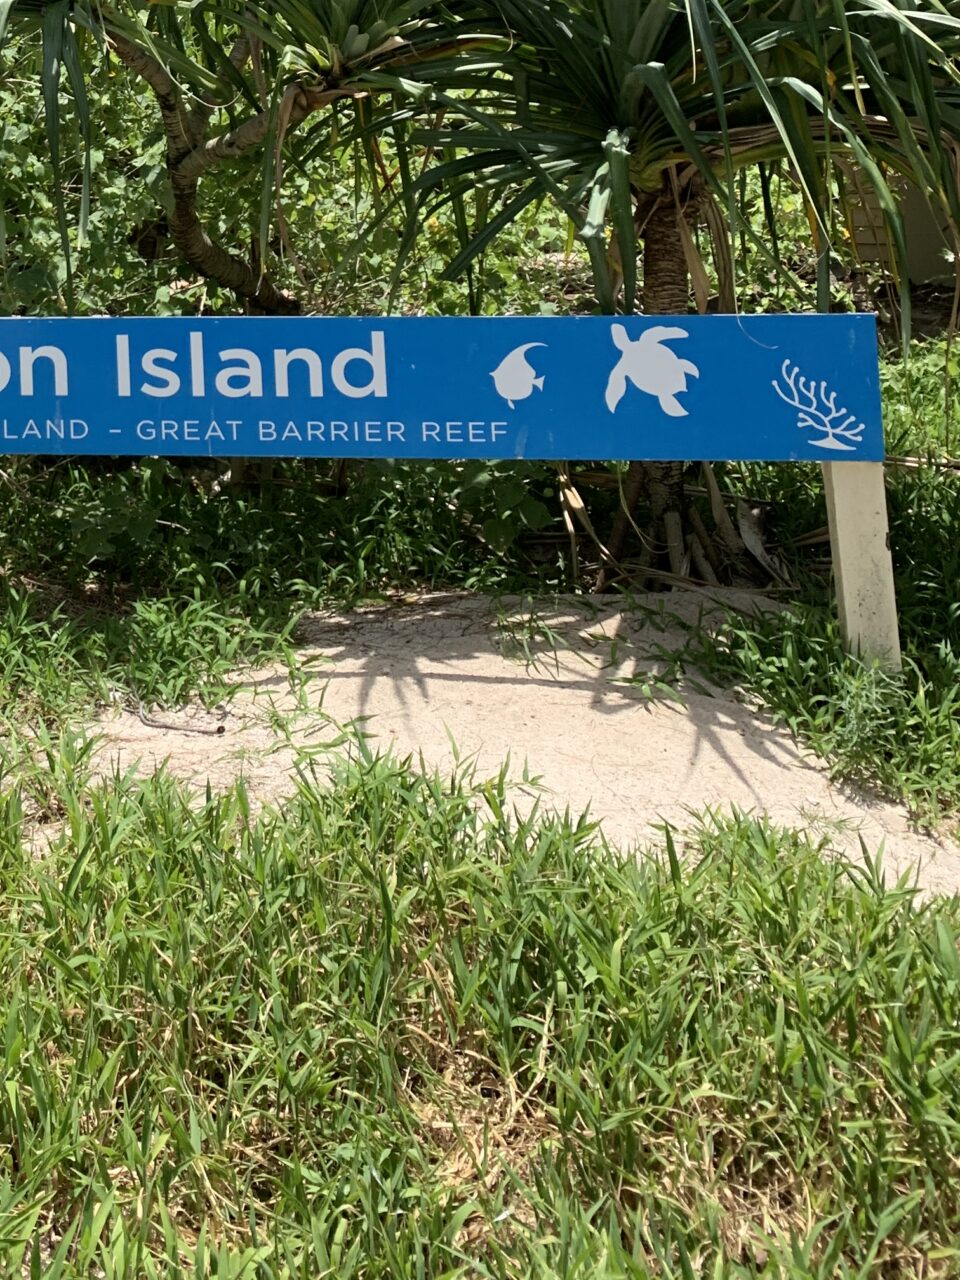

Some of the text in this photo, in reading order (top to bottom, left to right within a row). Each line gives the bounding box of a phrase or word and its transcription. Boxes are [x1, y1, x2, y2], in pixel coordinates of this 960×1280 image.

[115, 331, 388, 398] Island
[136, 419, 243, 441] GREAT
[258, 420, 406, 442] BARRIER
[422, 422, 508, 442] REEF
